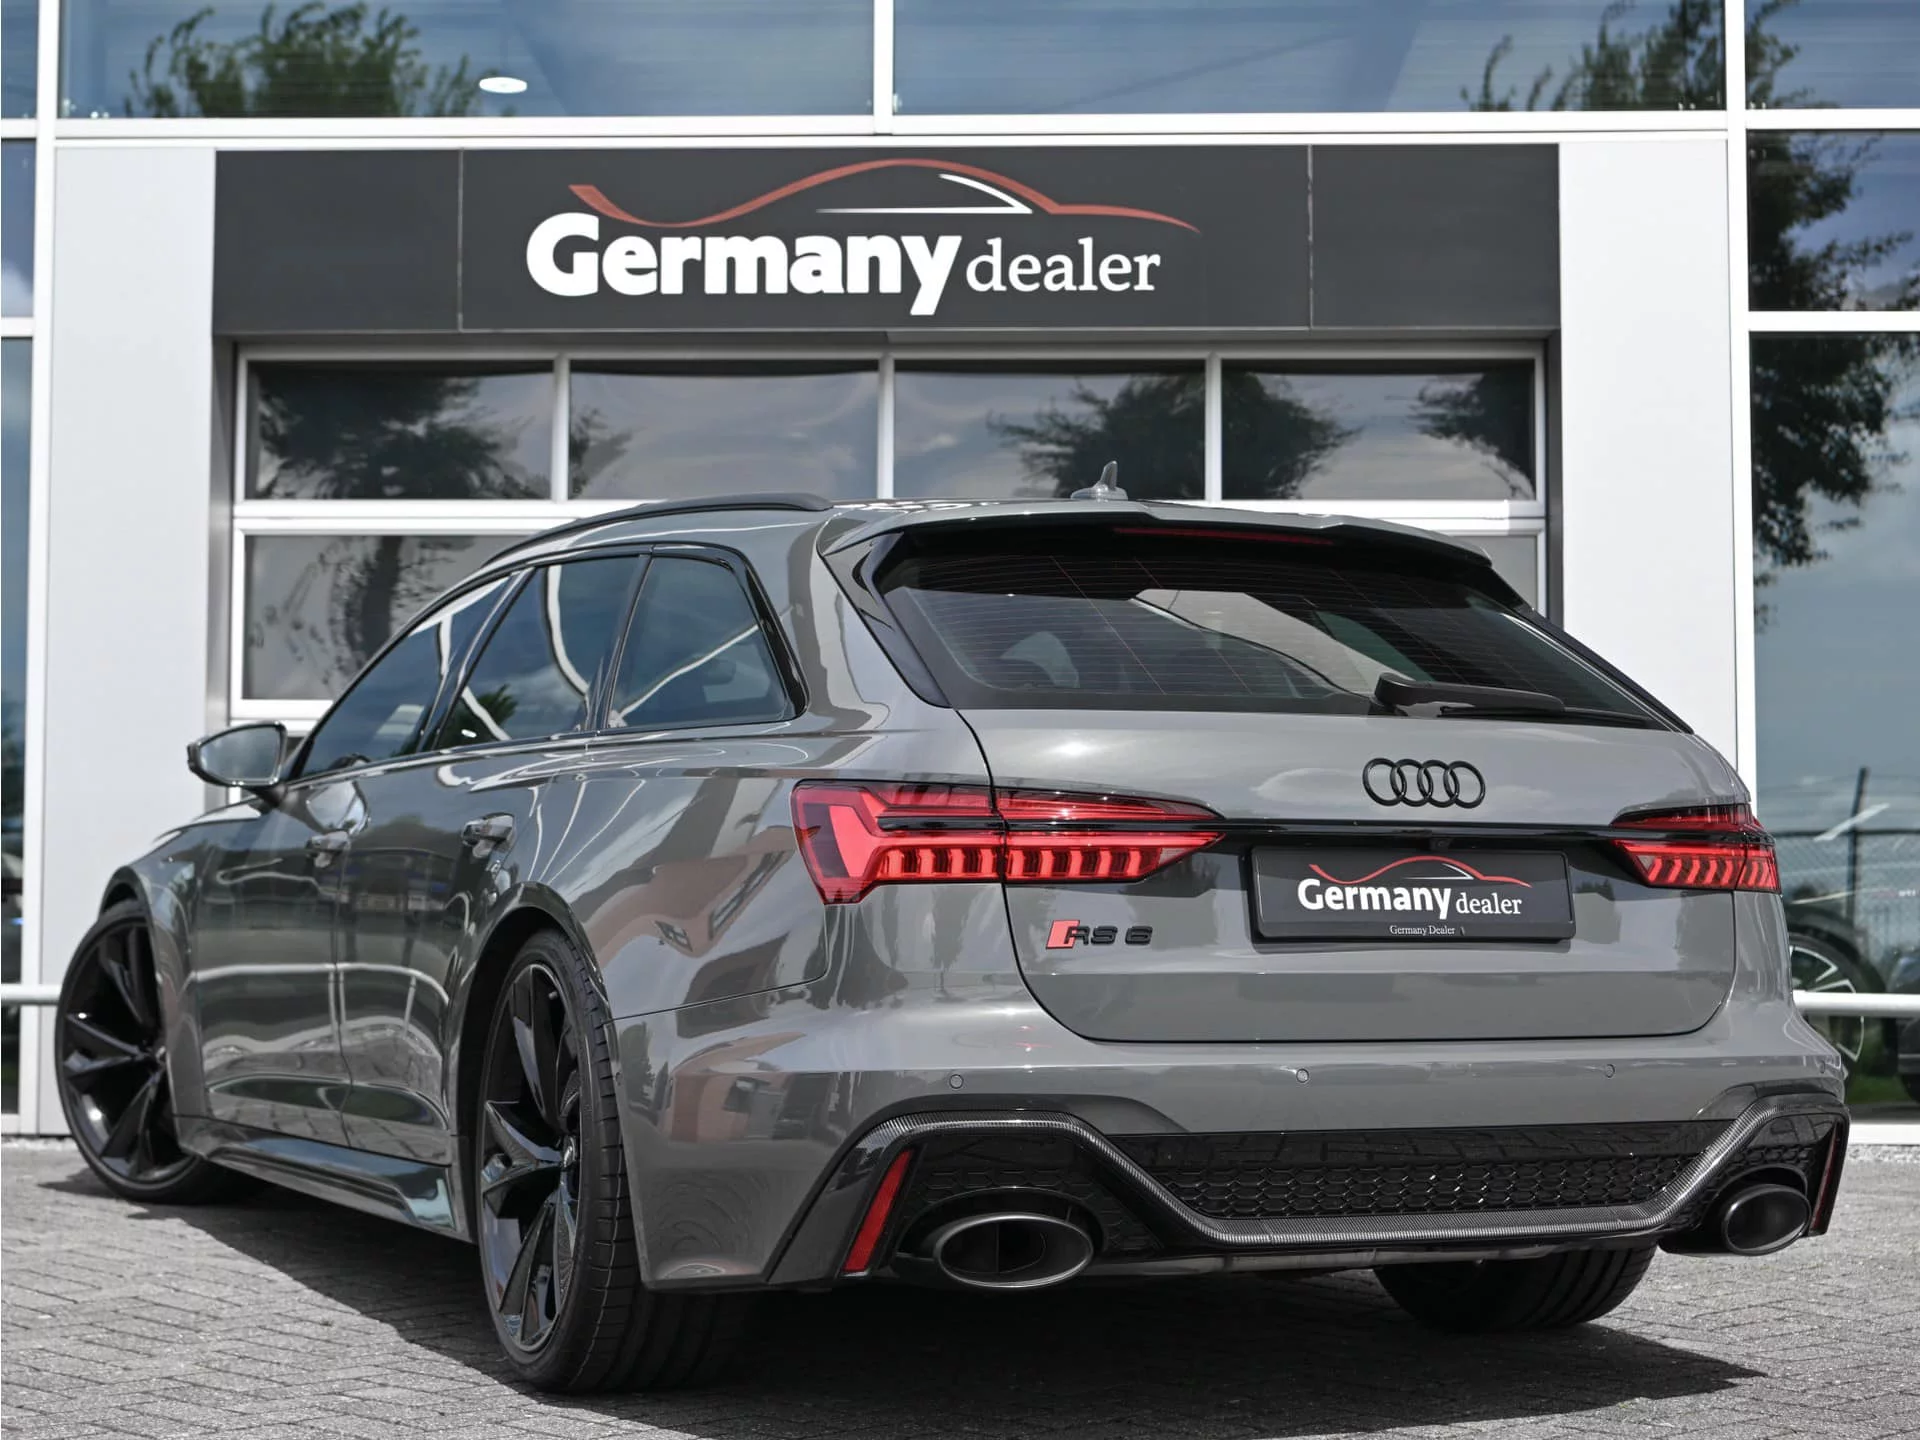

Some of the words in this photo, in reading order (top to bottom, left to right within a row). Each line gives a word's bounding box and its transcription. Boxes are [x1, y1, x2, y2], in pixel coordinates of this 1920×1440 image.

[526, 212, 963, 316] Germany
[965, 237, 1161, 293] dealer
[1297, 878, 1453, 920] Germany
[1454, 892, 1523, 915] dealer
[1389, 925, 1427, 936] Germany
[1428, 925, 1455, 935] Dealer
